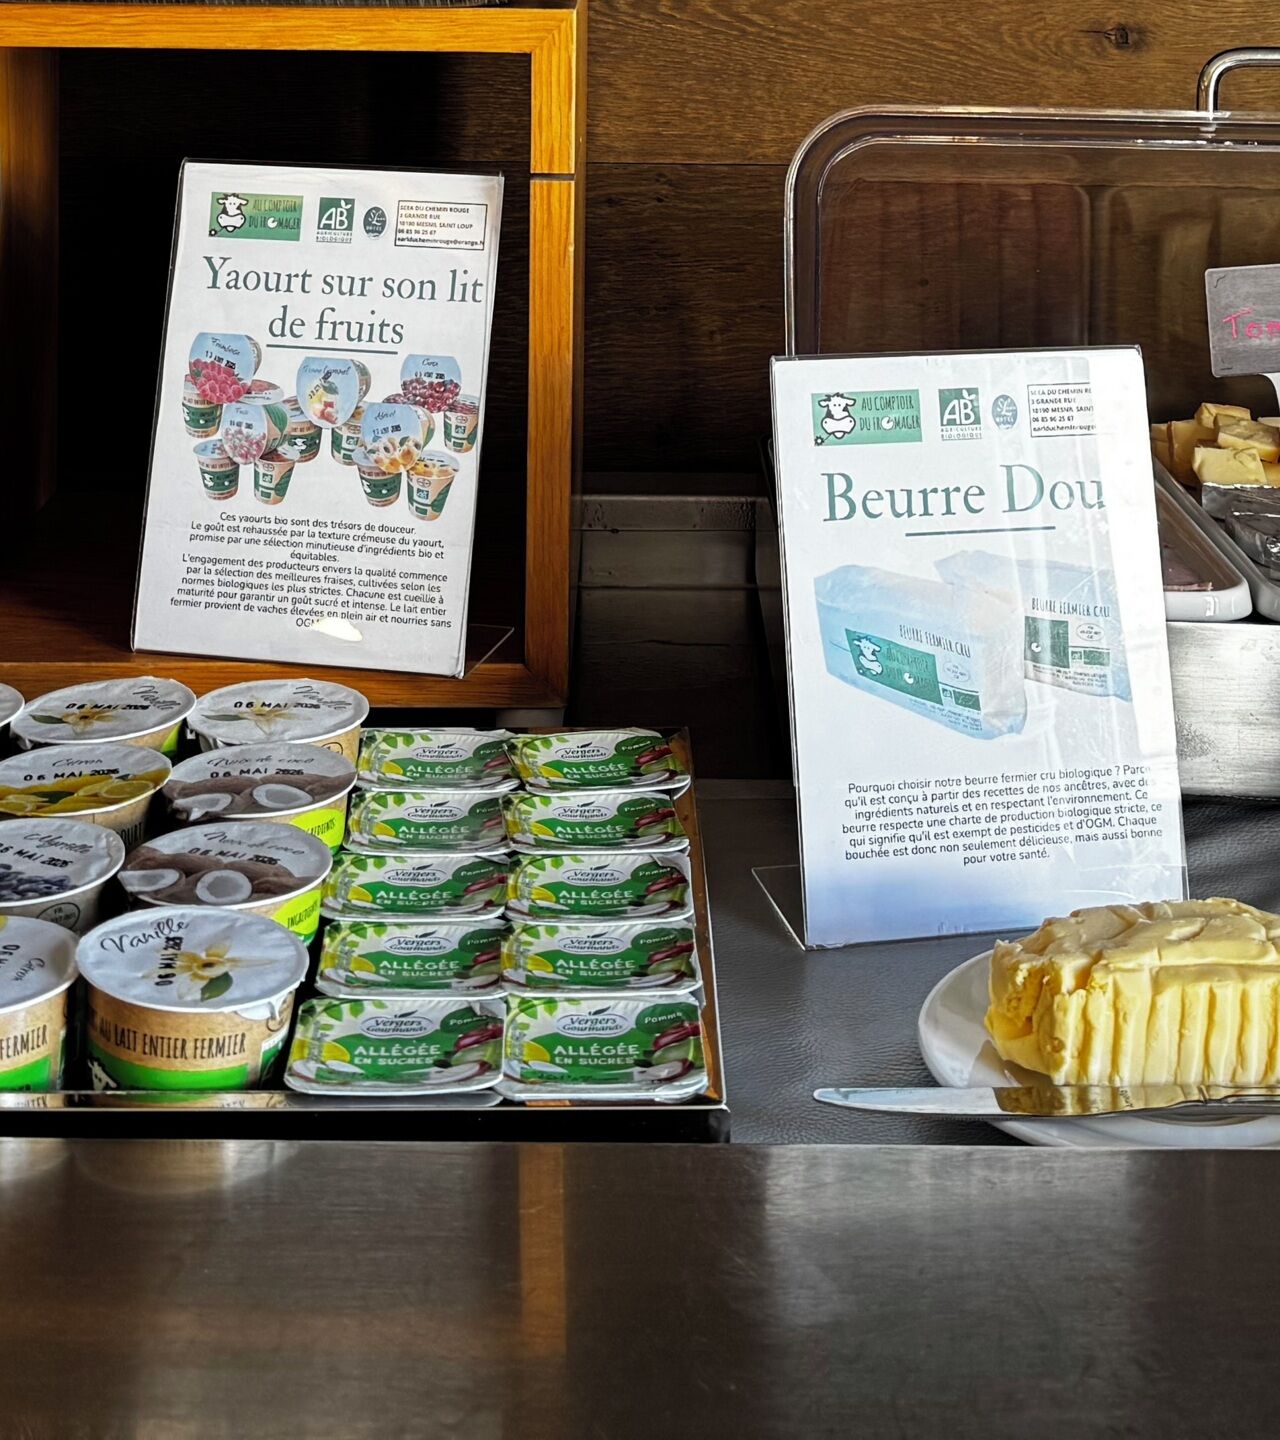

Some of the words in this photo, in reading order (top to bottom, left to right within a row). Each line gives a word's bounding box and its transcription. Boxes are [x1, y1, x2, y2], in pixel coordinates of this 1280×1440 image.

[202, 256, 312, 294] Yaourt
[321, 274, 373, 297] sur
[382, 277, 436, 300] son
[446, 268, 483, 303] lit
[269, 305, 305, 338] de
[315, 307, 404, 344] fruits
[821, 472, 985, 522] Beurre
[1000, 464, 1105, 513] Dou
[219, 511, 236, 524] Ces
[238, 515, 271, 526] yaourts
[274, 515, 288, 528] bio
[290, 518, 309, 530] sont
[312, 518, 328, 528] des
[330, 520, 361, 530] trésors
[364, 522, 375, 533] de
[54, 770, 84, 780] MAI
[848, 783, 894, 794] Pourquoi
[897, 778, 931, 790] choisir
[934, 778, 961, 787] notre
[964, 775, 998, 785] beurre
[1001, 771, 1037, 783] fermier
[1040, 772, 1055, 780] cru
[1059, 767, 1112, 779] biologique
[559, 889, 633, 898] ALLÉGÉE
[100, 917, 190, 953] Vanille
[569, 1015, 618, 1027] Vergers
[0, 1024, 48, 1057] FERMIER
[354, 1043, 441, 1056] ALLÉGÉE
[554, 1042, 640, 1056] ALLÉGÉE
[354, 1056, 372, 1065] EN
[554, 1056, 573, 1065] EN
